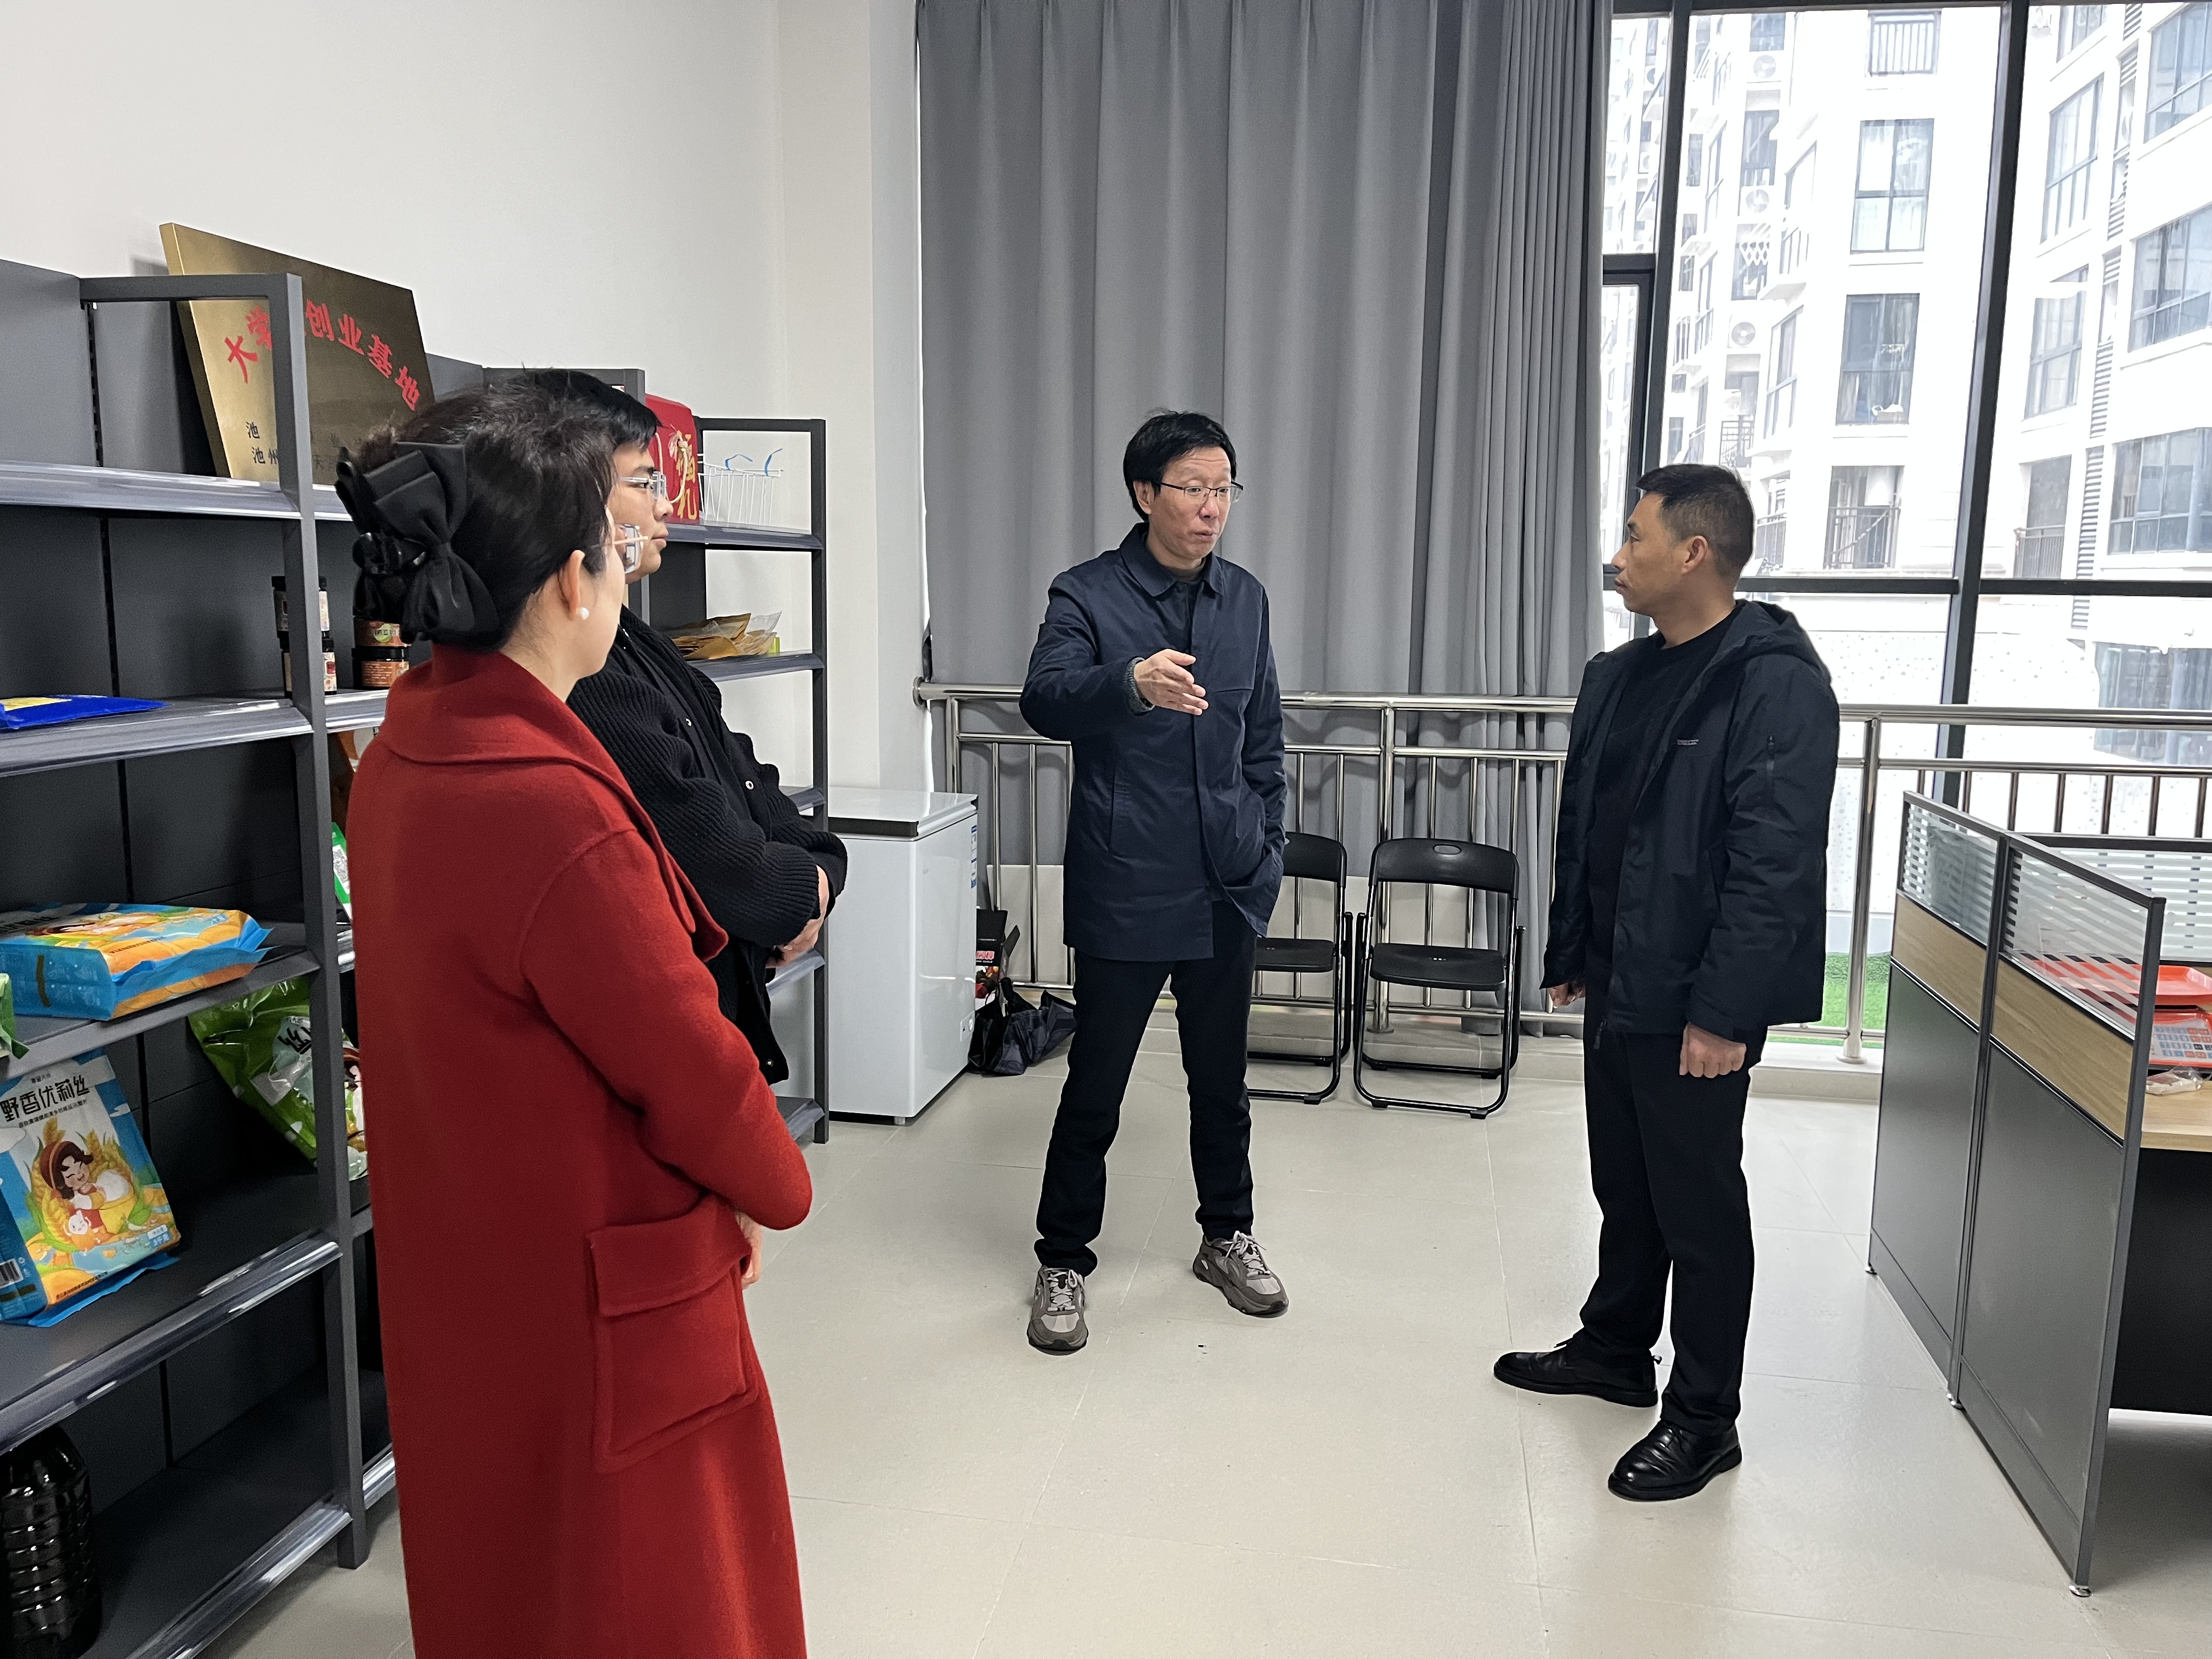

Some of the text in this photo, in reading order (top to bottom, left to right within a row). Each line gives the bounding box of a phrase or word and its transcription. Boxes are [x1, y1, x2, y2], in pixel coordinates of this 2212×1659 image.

[224, 299, 420, 411] 大学创业基地
